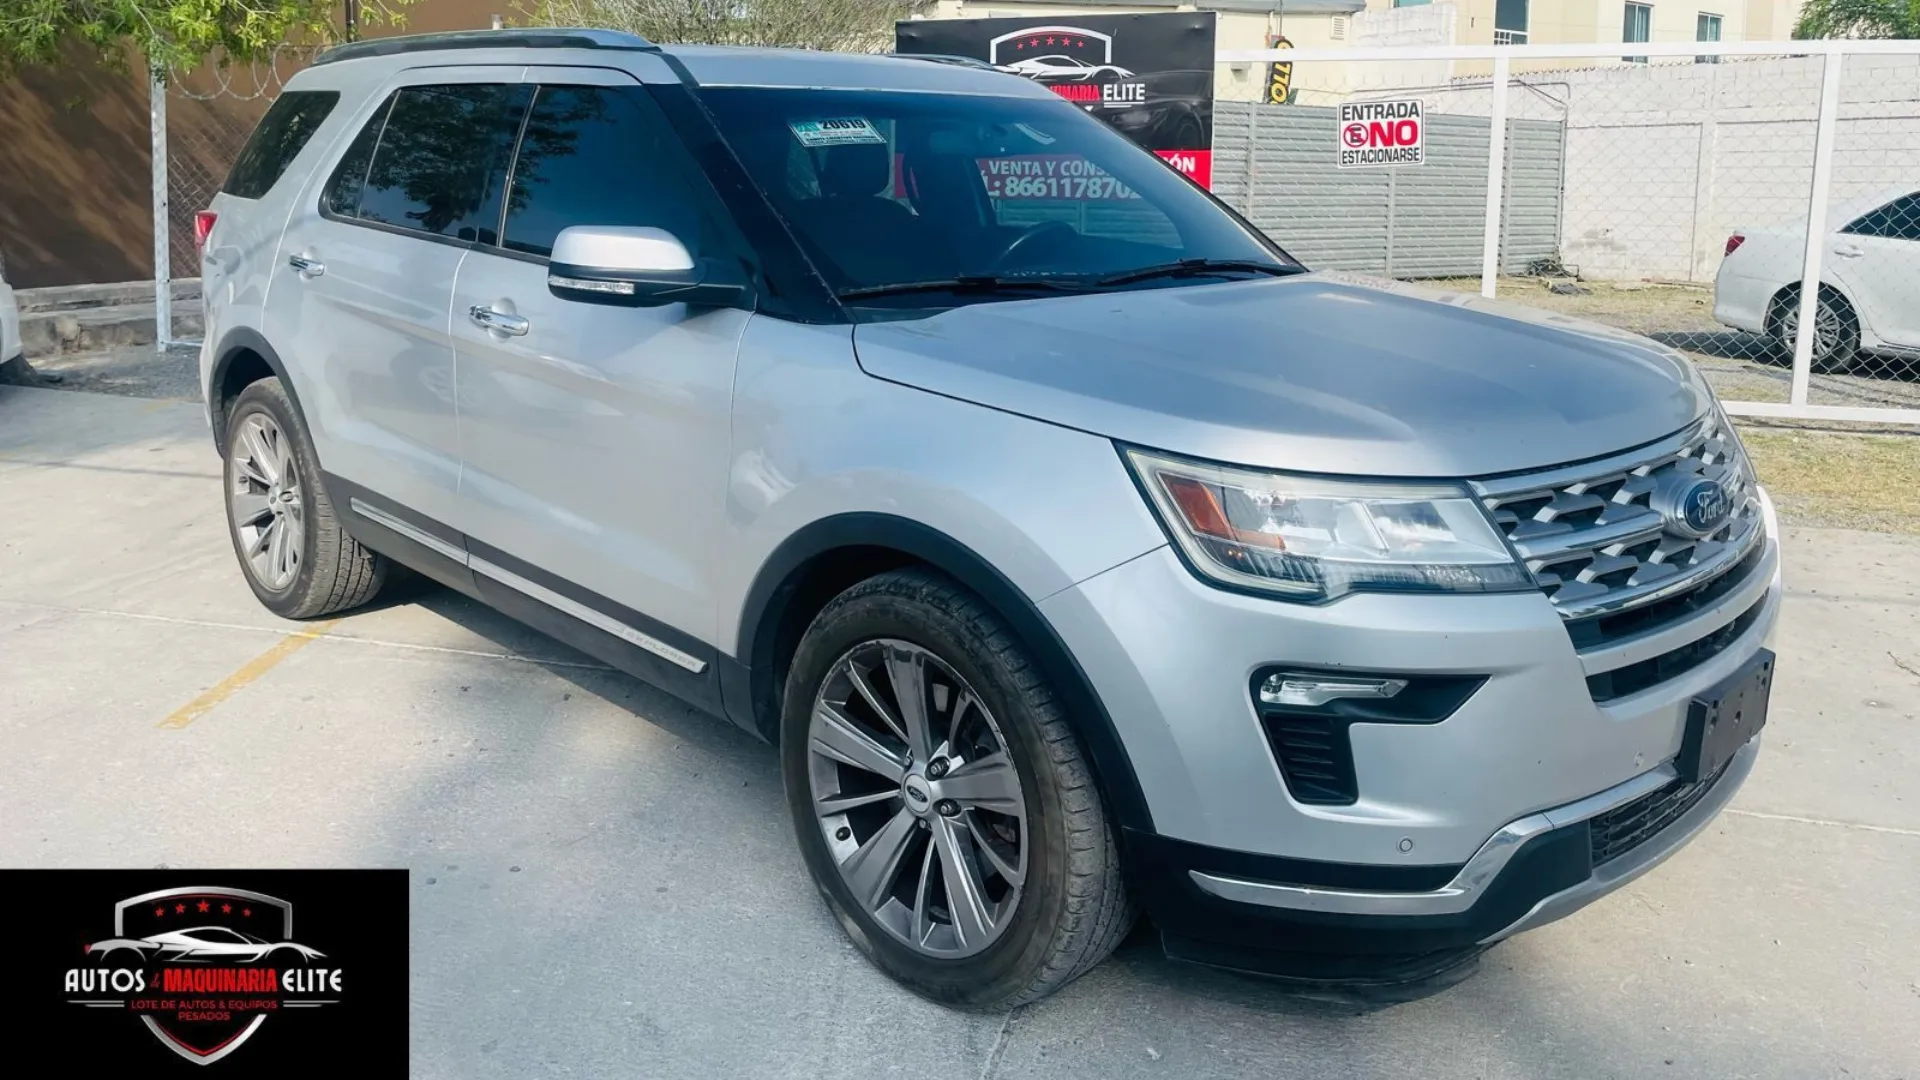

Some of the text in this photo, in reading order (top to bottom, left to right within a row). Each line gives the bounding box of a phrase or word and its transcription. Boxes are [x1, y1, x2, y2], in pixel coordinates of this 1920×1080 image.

[1103, 84, 1145, 101] ELITE
[1342, 102, 1419, 121] ENTRADA
[1370, 120, 1418, 147] NO
[1342, 147, 1420, 164] ESTACIONARSE
[988, 160, 1043, 175] VENTA
[1044, 160, 1057, 175] Y
[1697, 489, 1724, 523] Ford
